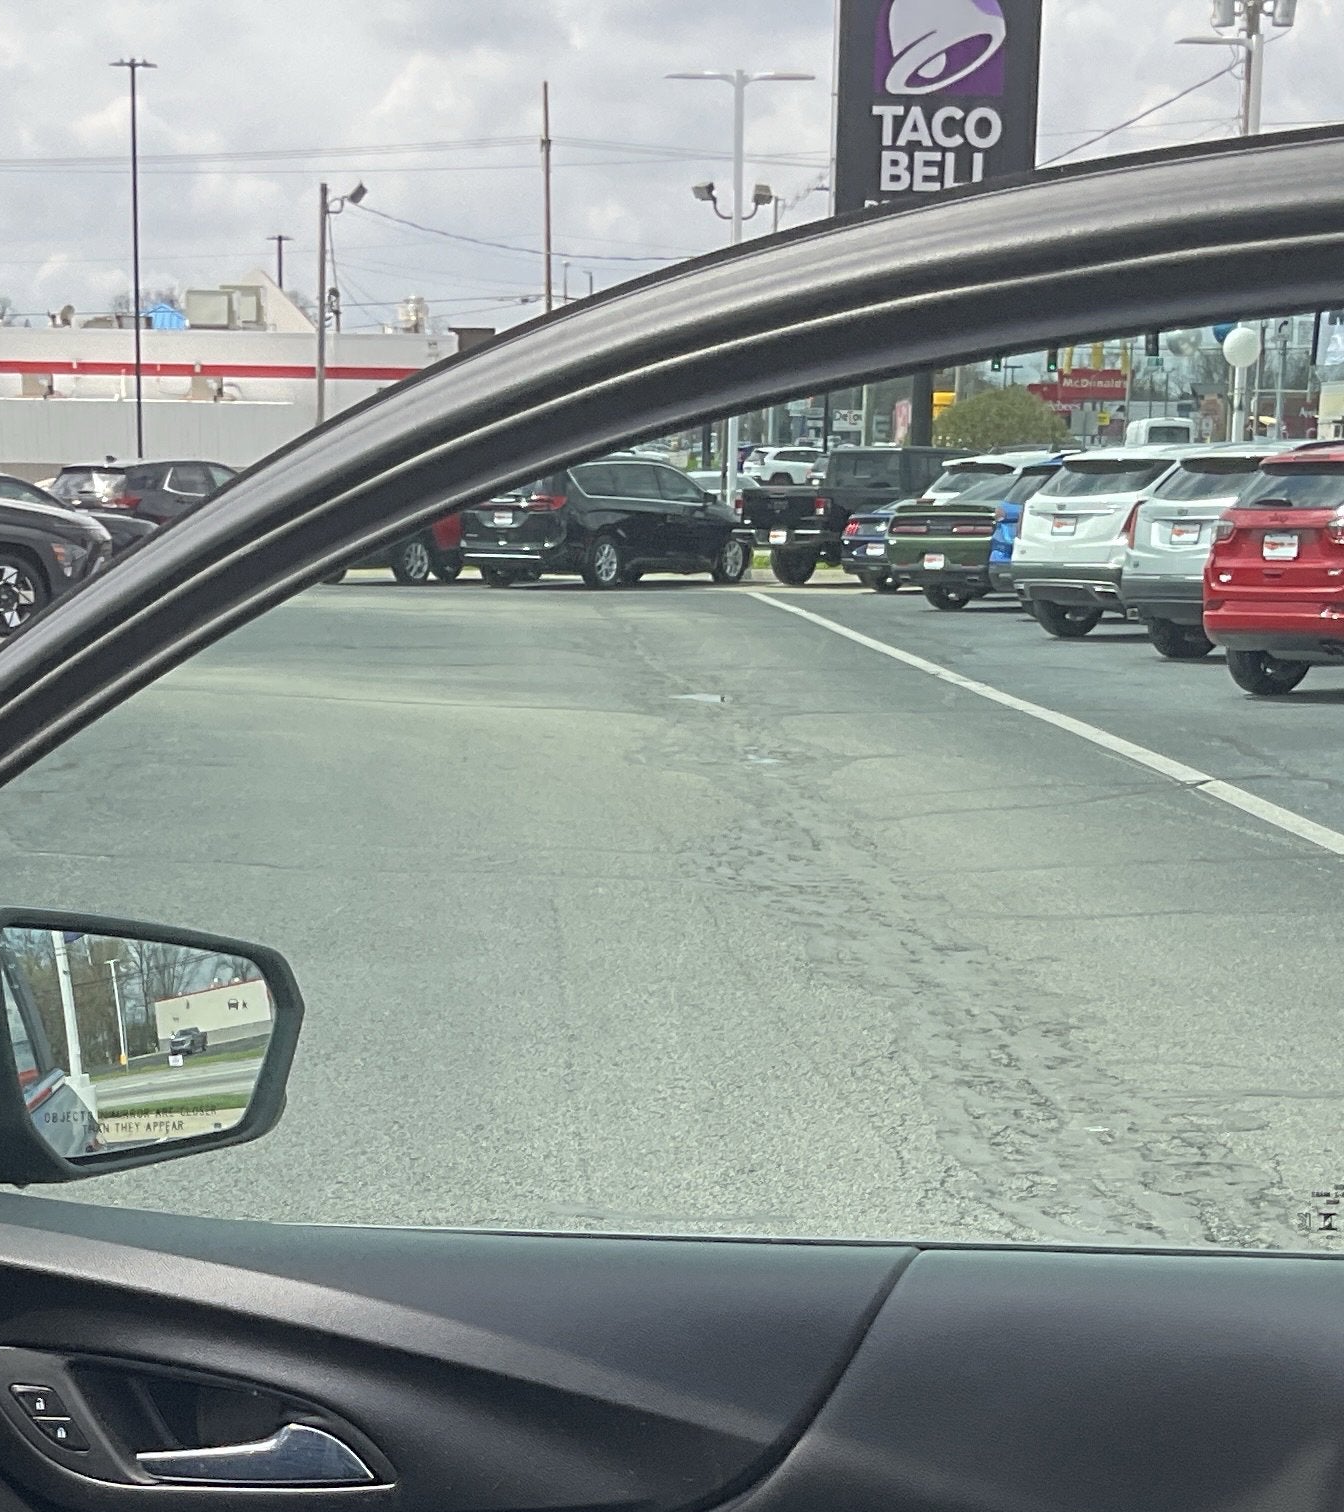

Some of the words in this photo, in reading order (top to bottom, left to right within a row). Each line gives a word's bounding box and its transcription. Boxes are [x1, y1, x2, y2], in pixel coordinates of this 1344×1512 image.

[872, 105, 1003, 149] TACO
[44, 1110, 93, 1124] OBJECTS
[115, 1122, 141, 1134] THEY
[145, 1120, 185, 1133] APPEAR
